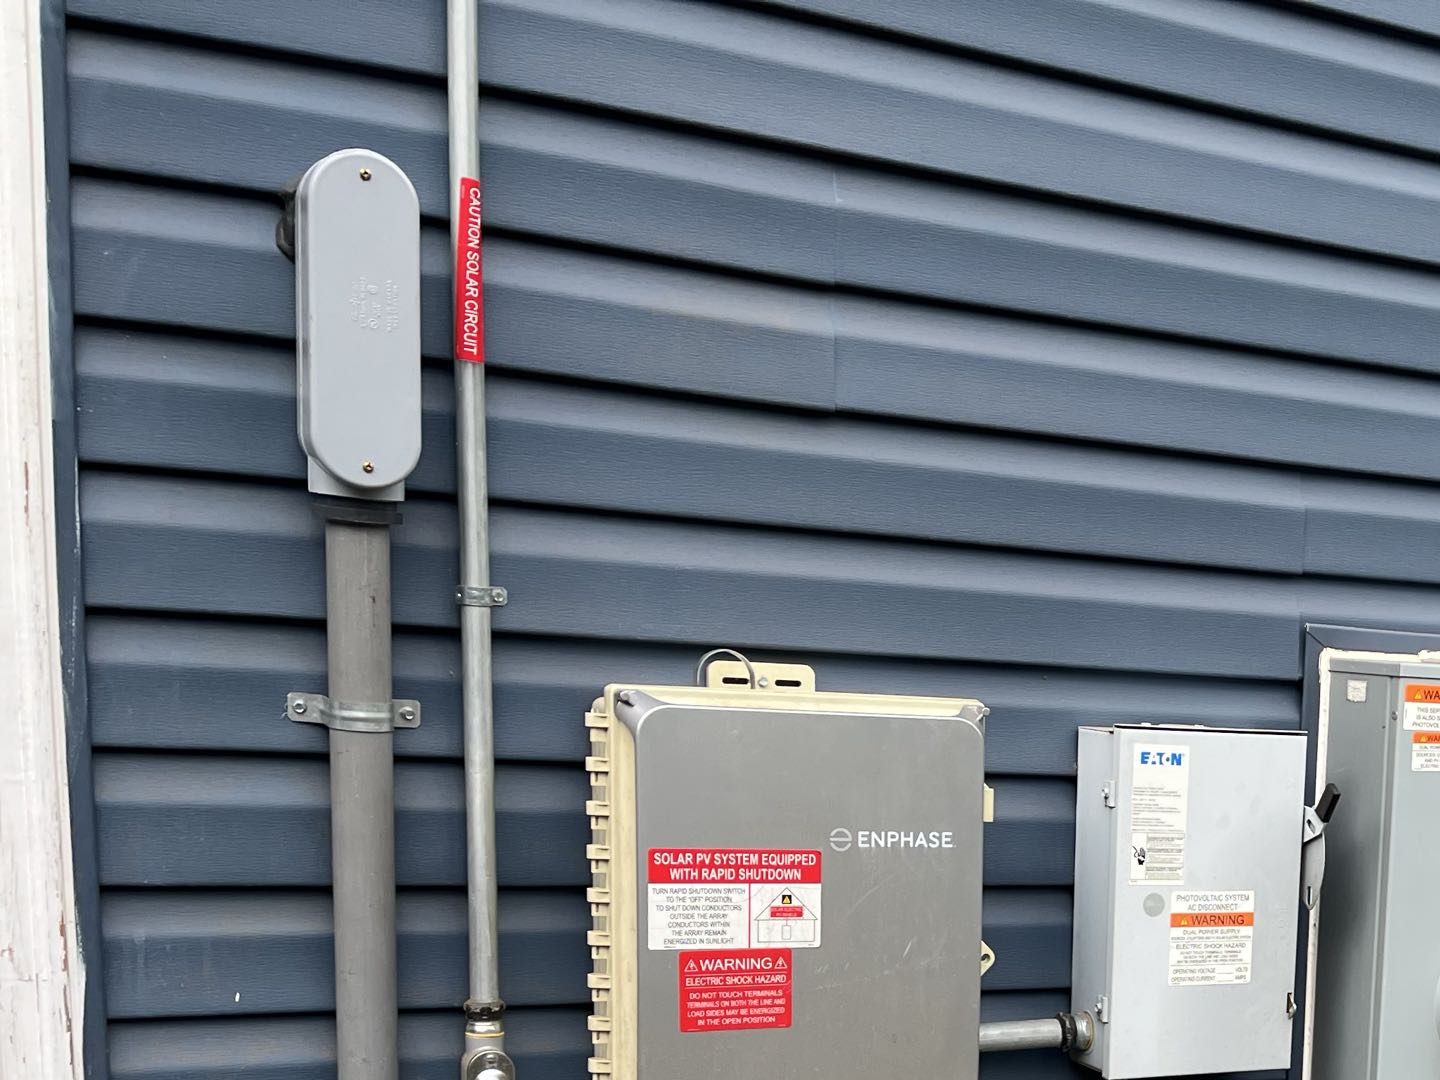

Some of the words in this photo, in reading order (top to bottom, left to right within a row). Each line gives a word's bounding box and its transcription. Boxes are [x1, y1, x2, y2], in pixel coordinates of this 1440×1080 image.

[468, 187, 481, 248] CAUTION
[466, 250, 480, 297] SOLAR
[463, 300, 478, 355] CIRCUIT
[1140, 751, 1182, 766] EATON
[857, 831, 953, 848] ENPHASE
[653, 852, 693, 865] SOLAR
[696, 853, 711, 865] PV
[713, 853, 758, 865] SYSTEM
[762, 853, 816, 866] EQUIPPED
[669, 868, 698, 880] WITH
[701, 868, 736, 880] RAPID
[738, 868, 801, 880] SHUTDOWN
[1176, 894, 1223, 902] PHOTOVOLTAIC
[1198, 903, 1238, 911] DISCONNECT
[1191, 915, 1245, 925] WARNING
[699, 957, 773, 971] WARNING
[685, 977, 724, 987] ELECTRIC
[725, 976, 754, 985] SHOCK
[754, 974, 787, 983] HAZARD
[689, 992, 700, 1000] DO
[744, 989, 783, 997] TERMINALS
[687, 1010, 705, 1018] LOAD
[750, 1006, 785, 1014] ENERGIZED
[721, 1017, 741, 1025] OPEN
[742, 1016, 776, 1024] POSITION
